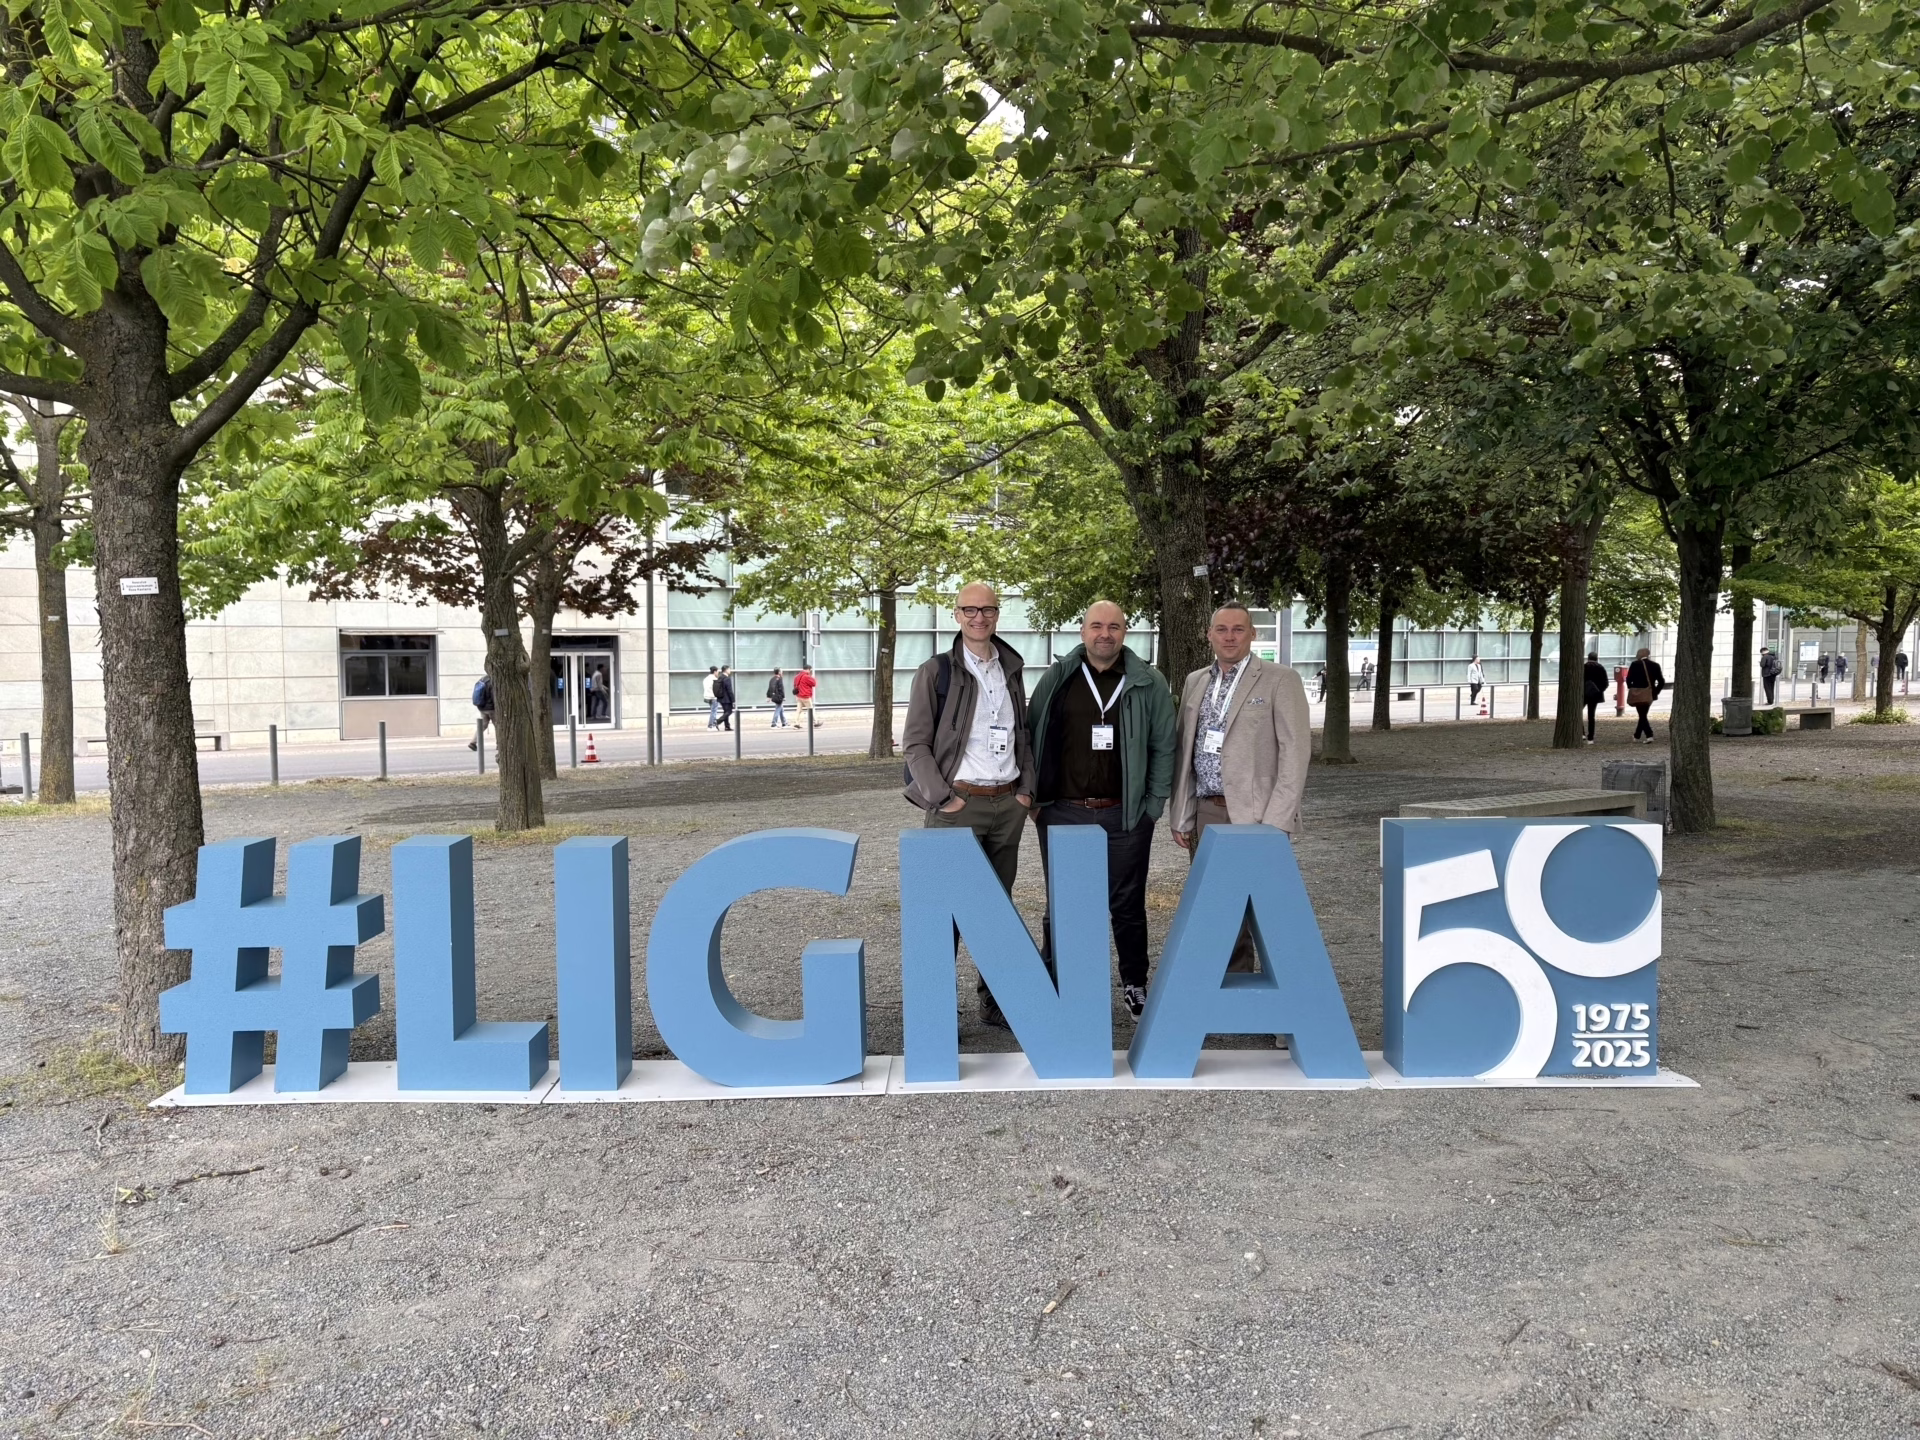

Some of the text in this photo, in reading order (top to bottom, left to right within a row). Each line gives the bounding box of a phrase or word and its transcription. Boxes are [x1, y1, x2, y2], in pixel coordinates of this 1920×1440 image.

[160, 824, 1367, 1095] #LIGNA
[1404, 824, 1663, 1079] 50
[1572, 1003, 1650, 1032] 1975
[1572, 1040, 1651, 1068] 2025
